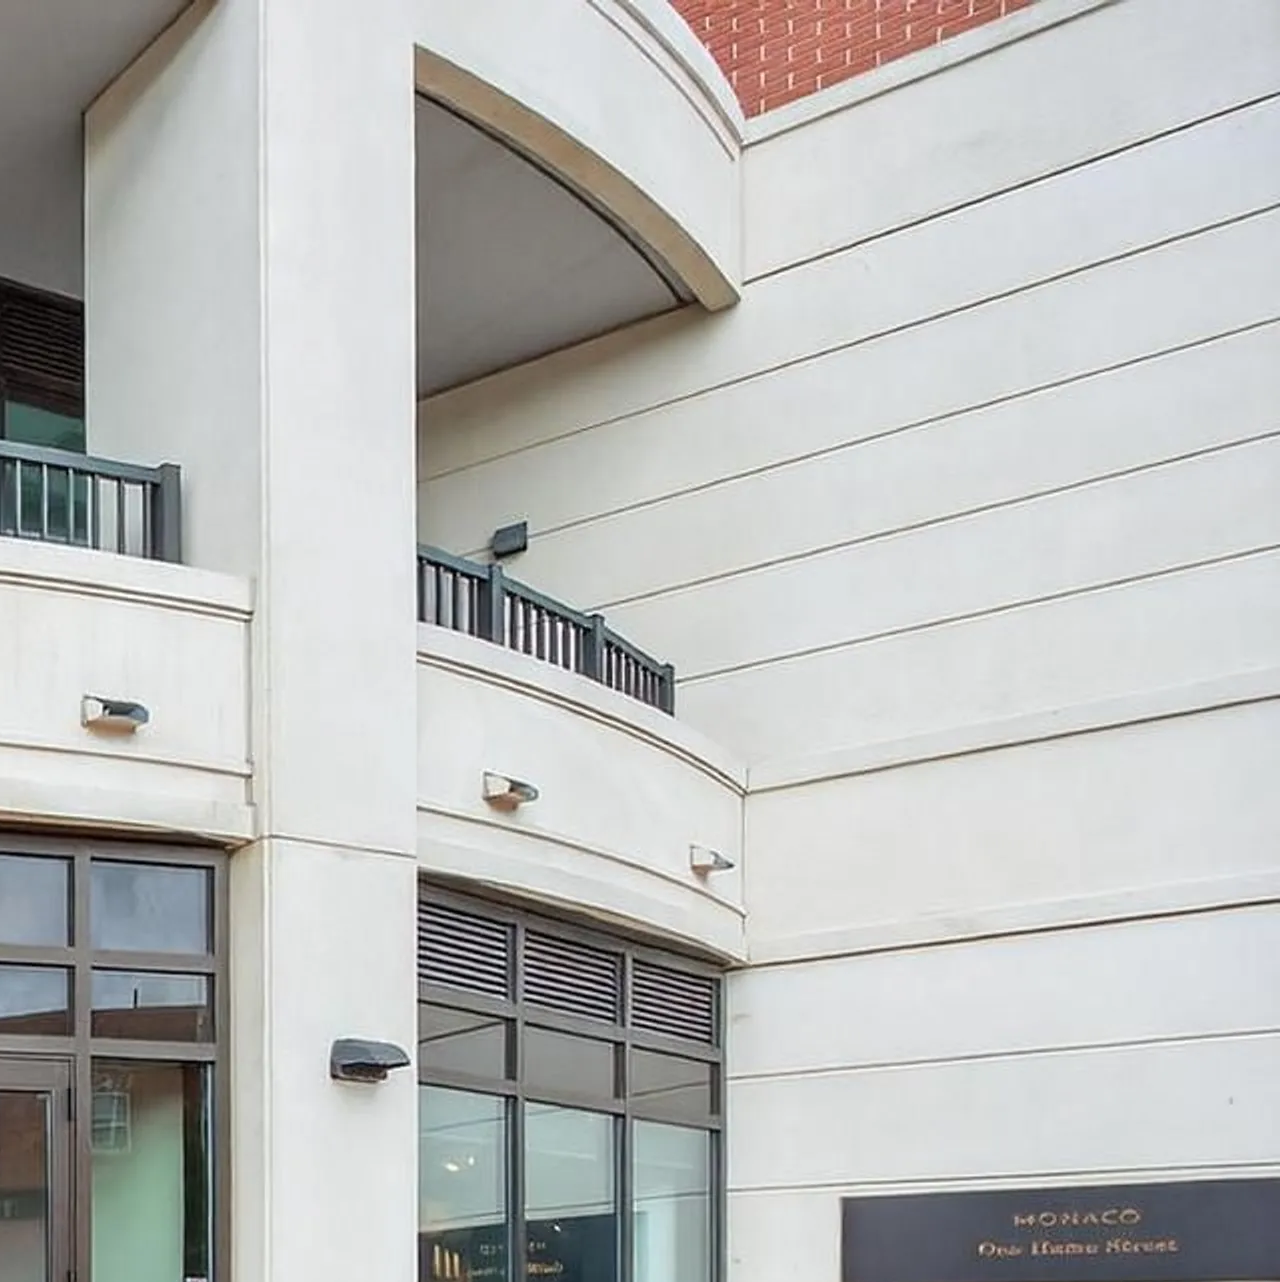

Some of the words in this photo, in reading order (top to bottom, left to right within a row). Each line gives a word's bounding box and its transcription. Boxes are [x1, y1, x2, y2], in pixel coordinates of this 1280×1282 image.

[1013, 1208, 1142, 1228] MONACO
[977, 1241, 1023, 1257] One
[1105, 1239, 1180, 1254] Street
